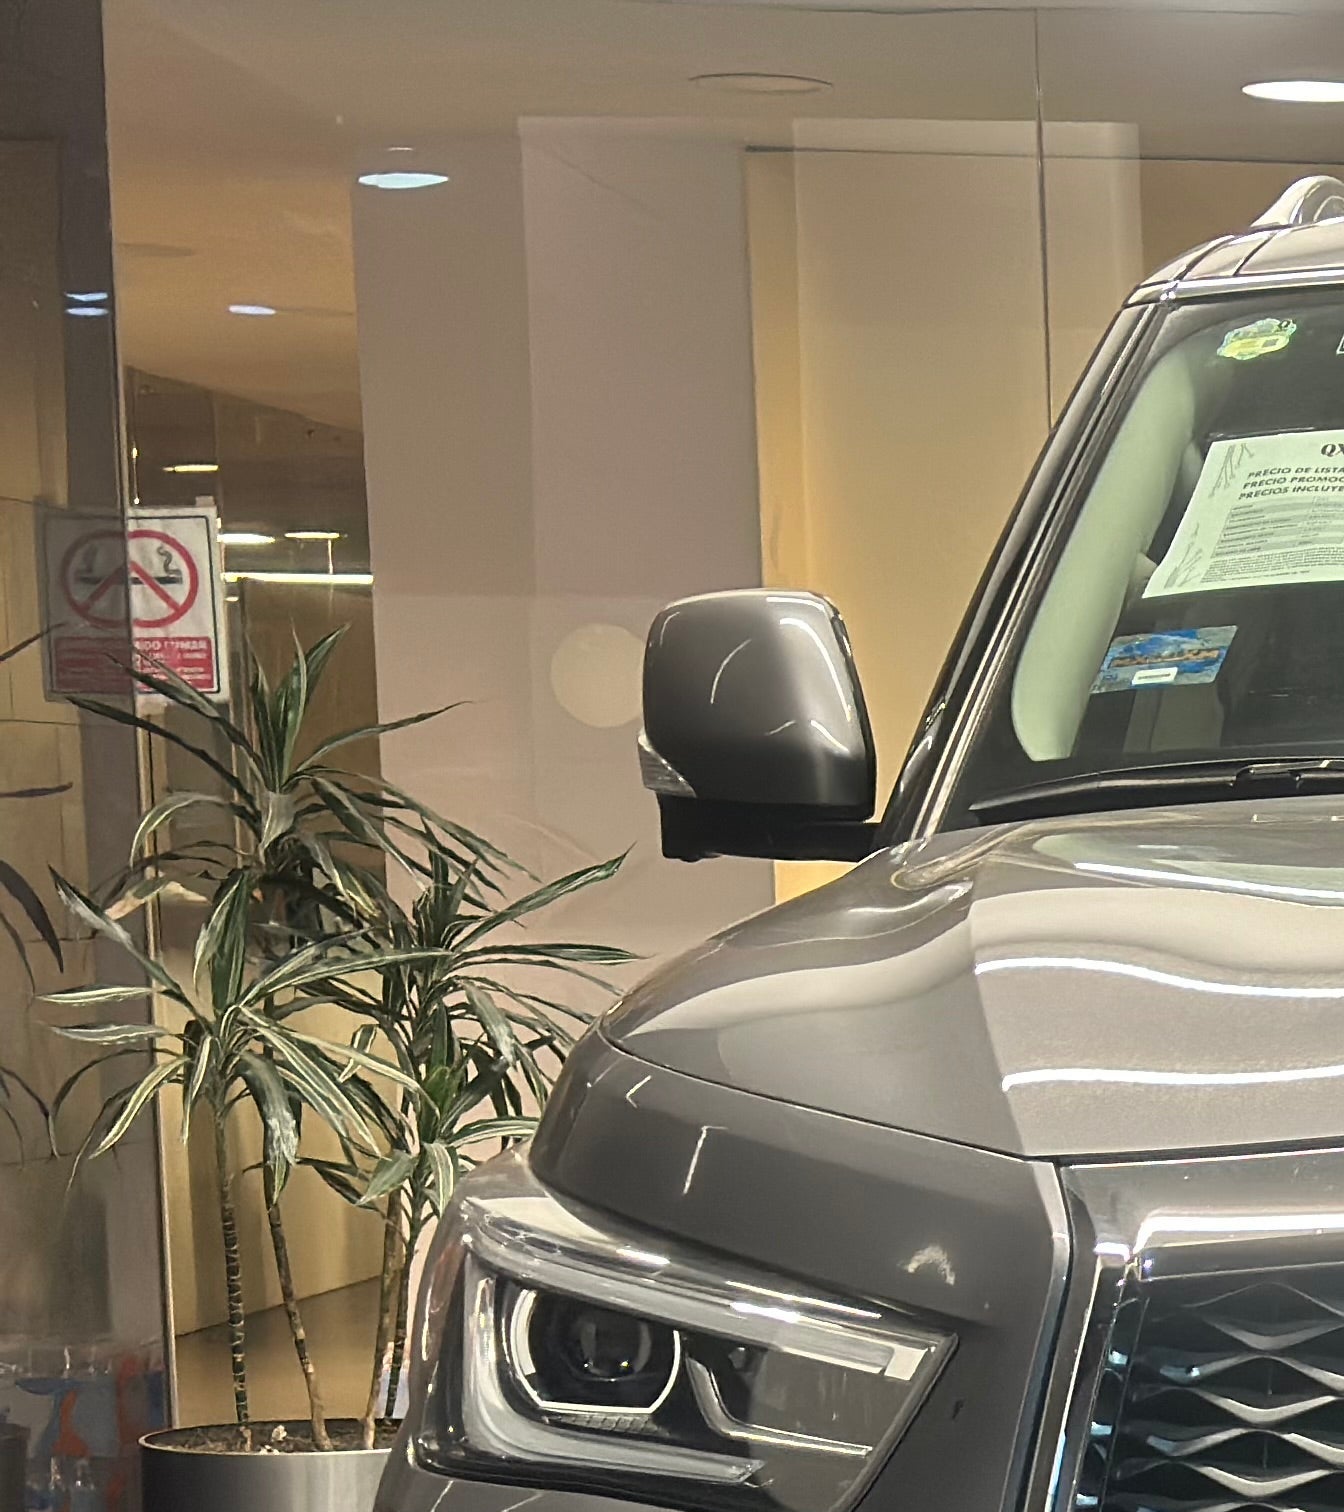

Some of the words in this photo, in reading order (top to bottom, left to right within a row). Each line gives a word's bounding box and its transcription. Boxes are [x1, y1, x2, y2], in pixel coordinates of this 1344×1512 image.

[1248, 467, 1292, 478] PRECIO
[1243, 477, 1287, 489] PRECIO
[1239, 486, 1289, 500] PRECIOS
